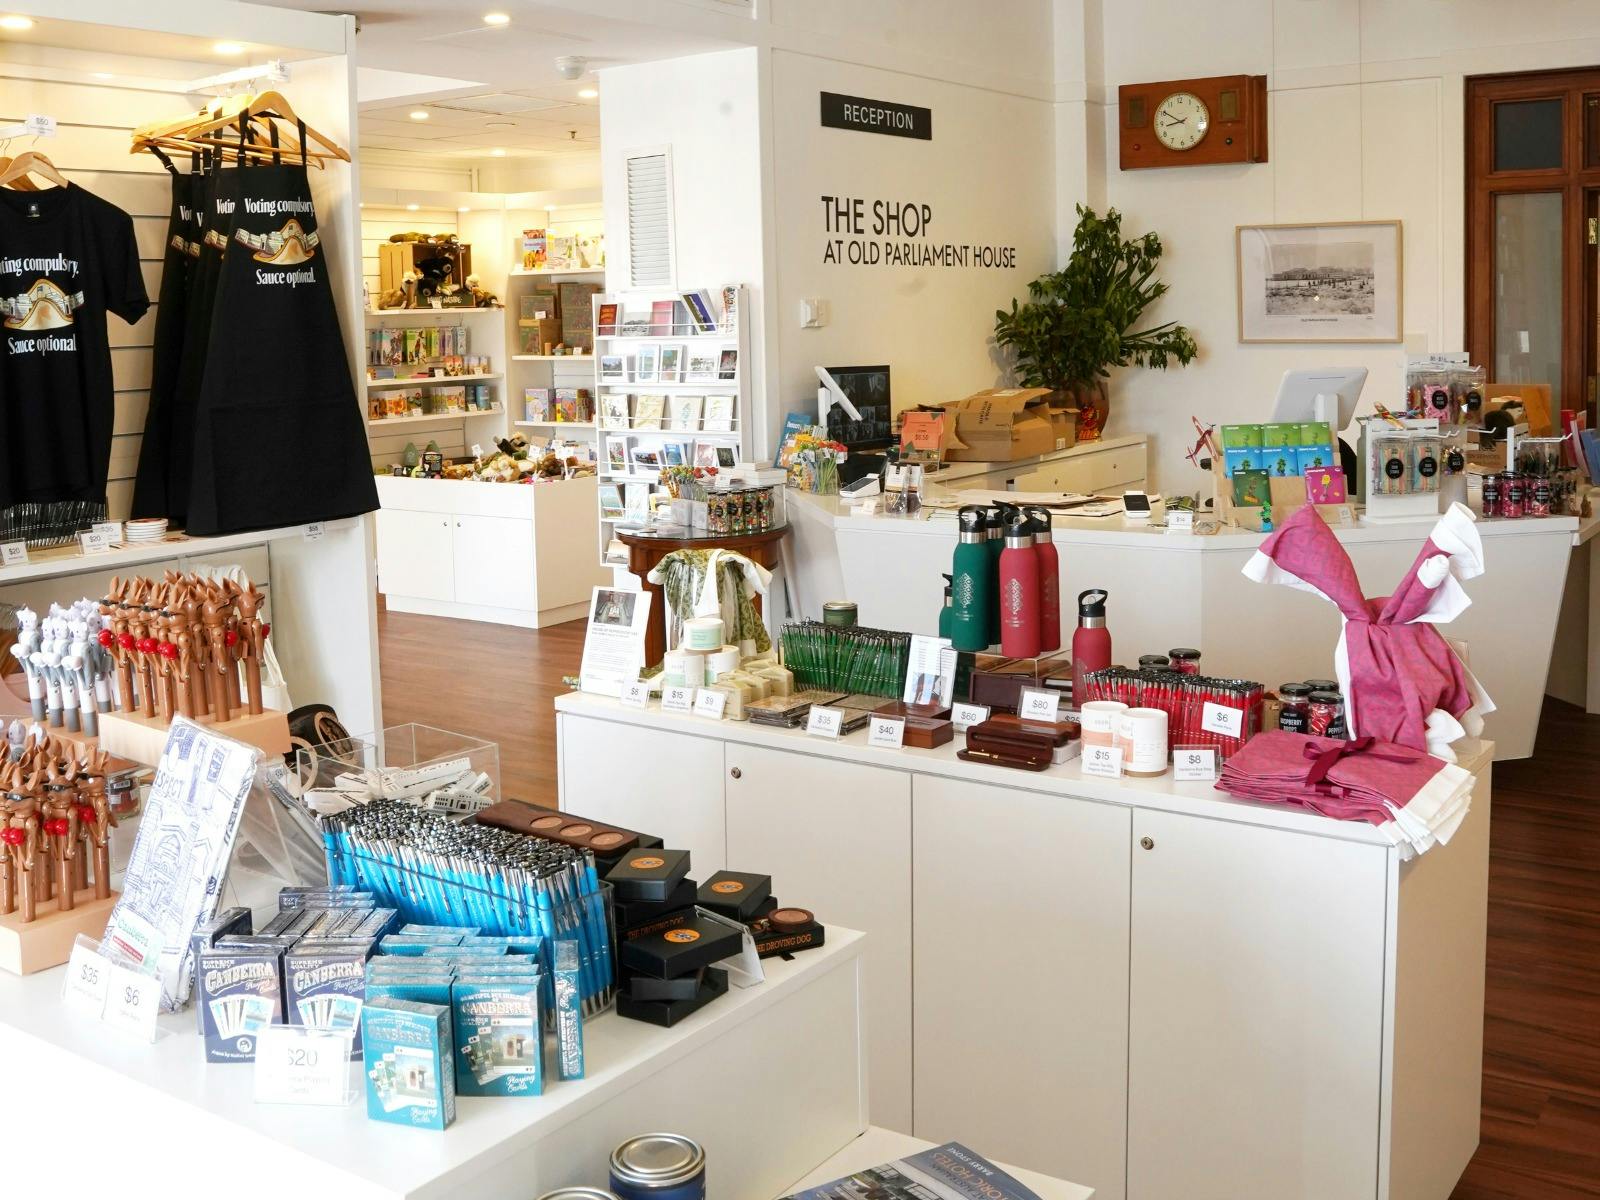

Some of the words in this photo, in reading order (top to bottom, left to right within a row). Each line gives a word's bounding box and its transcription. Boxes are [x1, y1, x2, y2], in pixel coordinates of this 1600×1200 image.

[844, 104, 914, 130] RECEPTION
[216, 198, 237, 215] Votin
[244, 198, 276, 217] Voting
[821, 196, 865, 235] THE
[872, 200, 932, 238] SHOP
[823, 239, 843, 265] AT
[848, 240, 881, 265] OLD
[885, 242, 970, 268] PARLIAMENT
[973, 245, 1017, 268] HOUSE
[0, 256, 22, 277] ting
[23, 252, 80, 278] compulsry.
[256, 268, 286, 285] Sauce
[7, 336, 36, 355] Sauce
[89, 535, 101, 543] $20
[8, 547, 20, 556] $20
[671, 690, 683, 700] $15
[1032, 698, 1048, 710] $80
[816, 714, 831, 725] $35
[960, 711, 977, 722] $60
[1216, 712, 1229, 723] $6
[878, 725, 894, 736] $40
[1094, 750, 1110, 761] $15
[1188, 755, 1201, 765] $8
[756, 943, 766, 953] HE
[766, 936, 797, 950] DROVING
[796, 933, 812, 945] DOG
[81, 964, 98, 985] $35
[293, 962, 364, 994] CANBERRA
[125, 986, 140, 1006] $6
[462, 1002, 532, 1016] CANBERRA
[288, 1048, 318, 1066] $20
